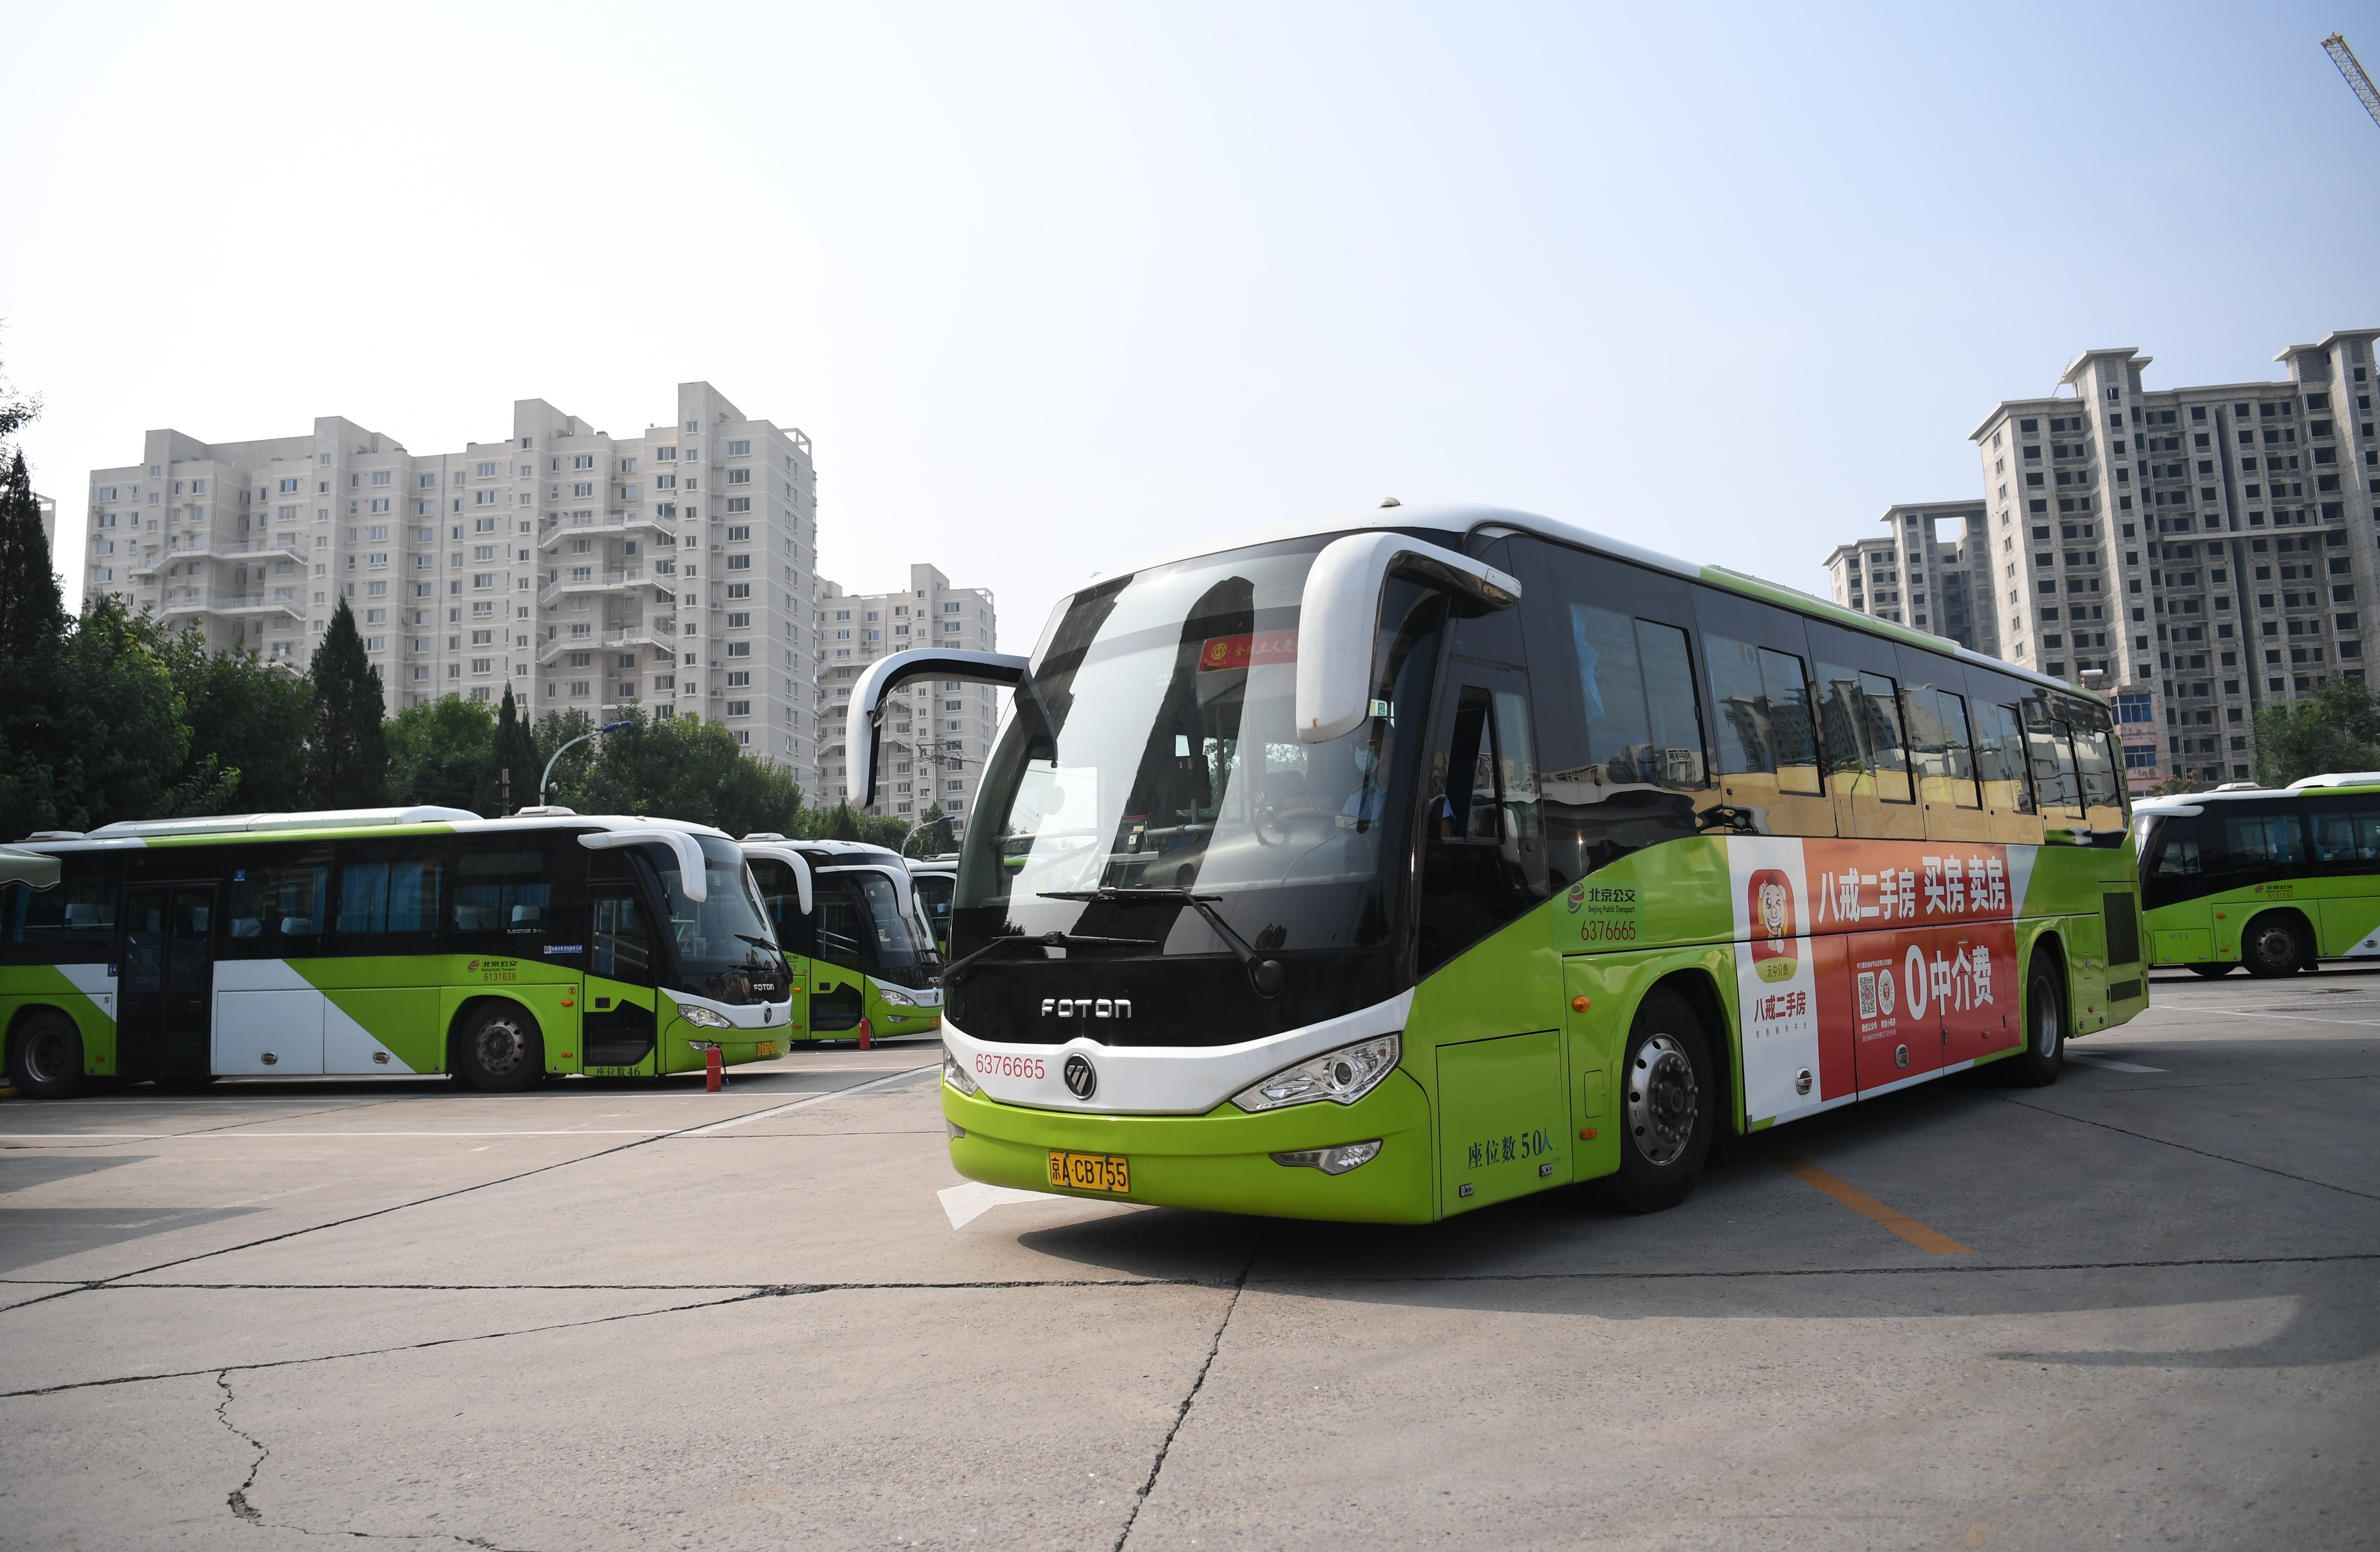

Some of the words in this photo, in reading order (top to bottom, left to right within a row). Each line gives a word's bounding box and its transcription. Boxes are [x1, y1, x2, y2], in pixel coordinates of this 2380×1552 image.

[1235, 638, 1298, 656] 全国工人先
[1589, 888, 1635, 902] 北京公交
[1818, 867, 1916, 924] 八戒二手房
[1922, 854, 1964, 915] 买房
[1968, 854, 2006, 912] 卖房
[1588, 905, 1602, 914] Beijing
[1615, 906, 1635, 914] Transport
[1581, 920, 1636, 941] 6376665
[484, 972, 516, 981] 6131636
[1767, 963, 1788, 977] 无中介费
[1905, 945, 1993, 1020] 0中介费
[1042, 999, 1132, 1018] FOTON
[1754, 990, 1806, 1023] 八戒二手房
[976, 1053, 1045, 1080] 6376665
